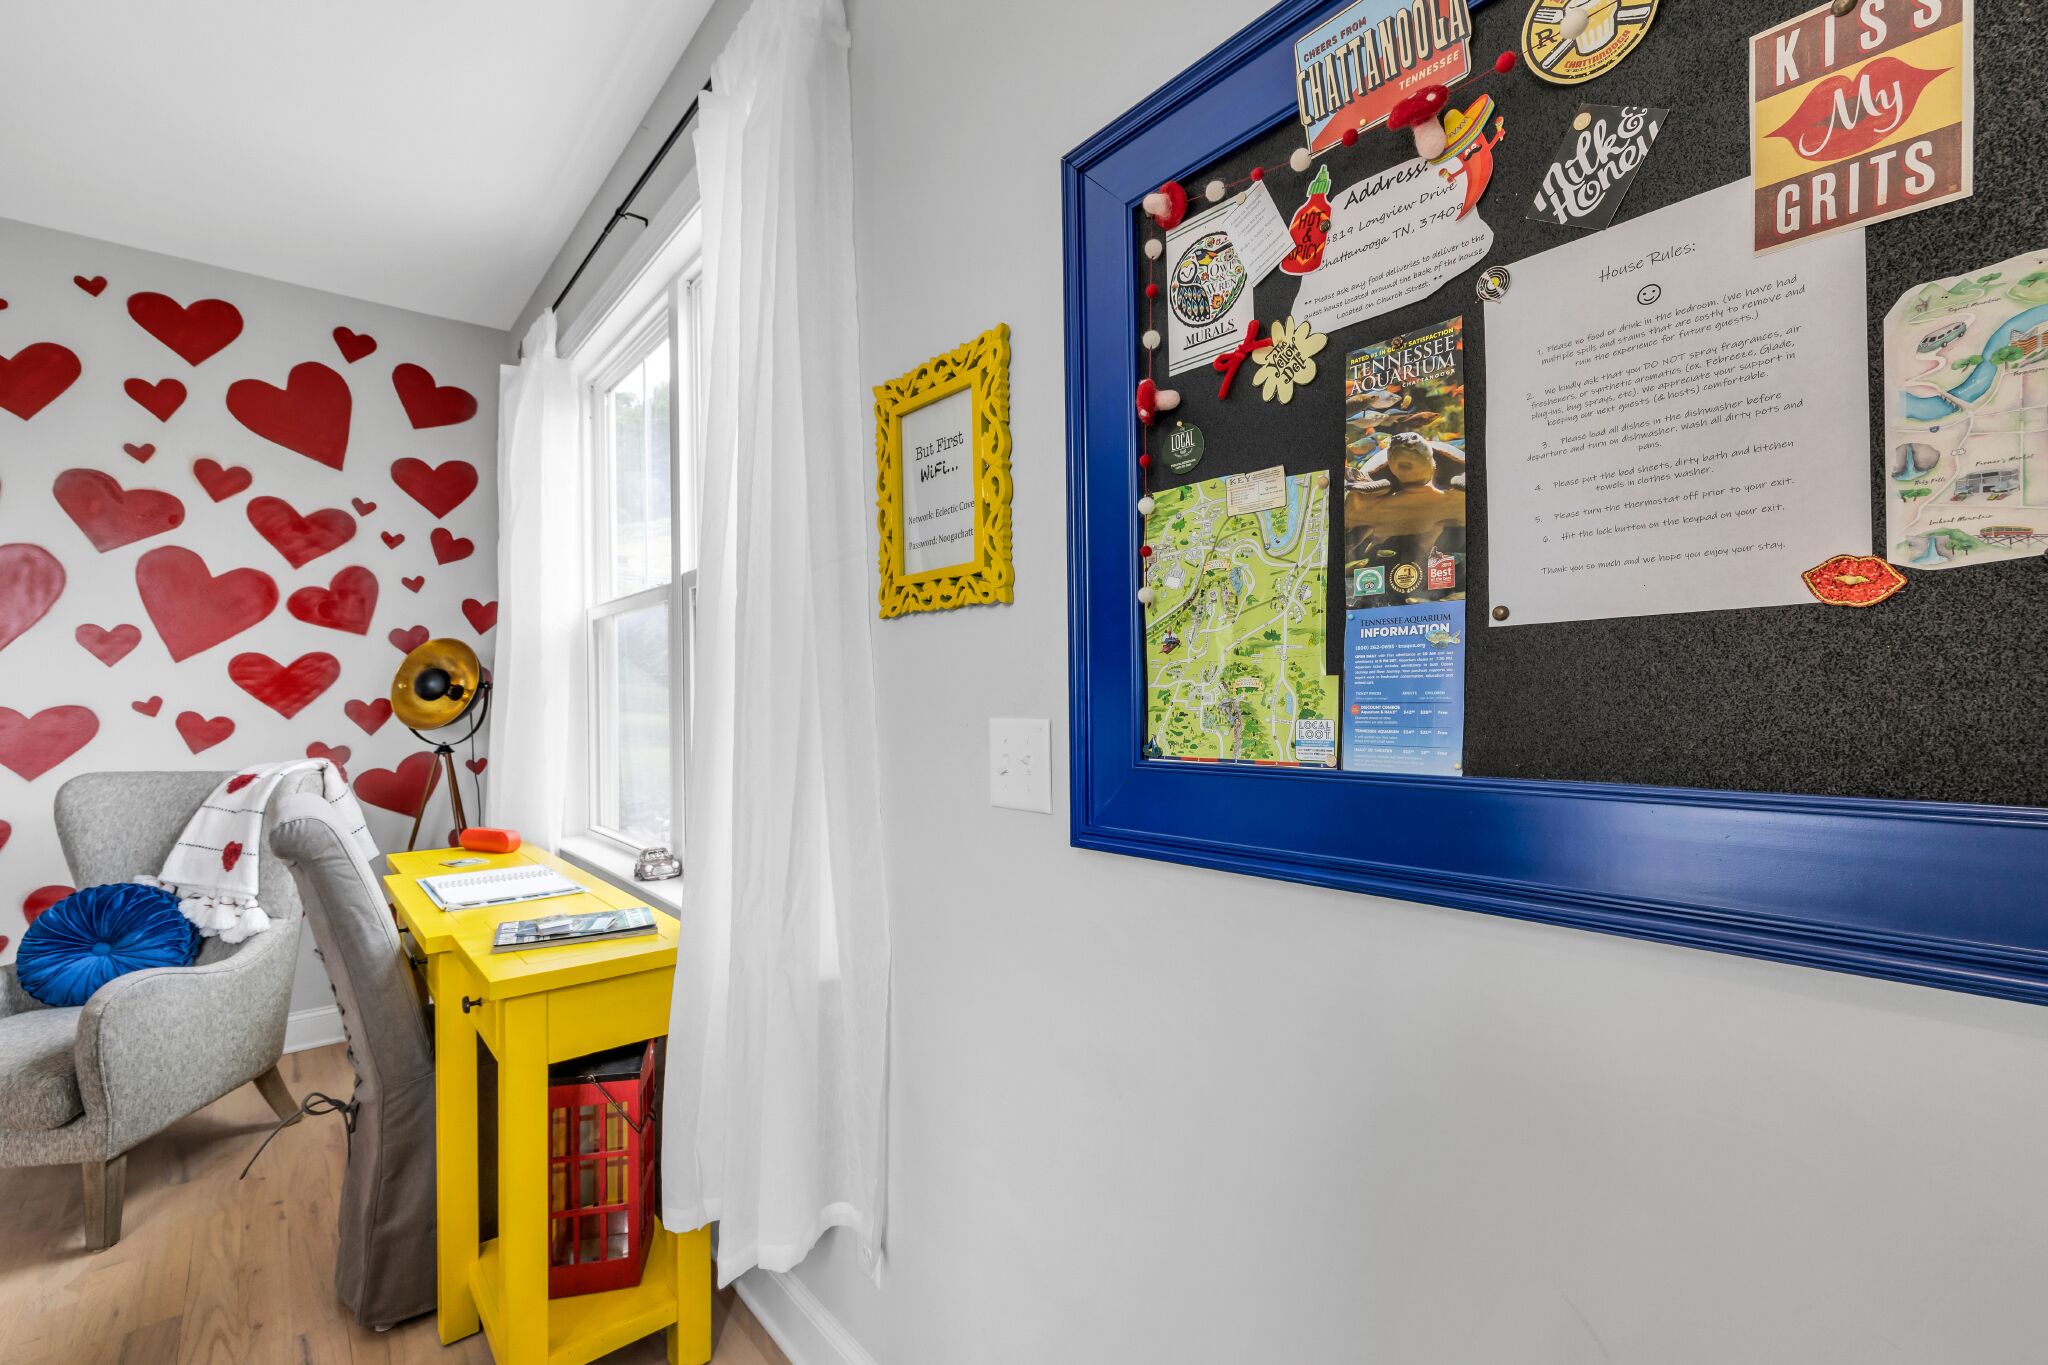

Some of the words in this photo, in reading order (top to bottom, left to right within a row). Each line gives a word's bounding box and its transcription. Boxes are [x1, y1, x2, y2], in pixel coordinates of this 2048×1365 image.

[1304, 35, 1339, 62] CHEERS
[1341, 16, 1368, 40] FROM
[1564, 30, 1631, 69] CHATTANOOGA
[1298, 0, 1467, 125] CHATTANOOGA
[1399, 50, 1459, 91] TENNESSEE
[1617, 106, 1648, 139] &
[1799, 74, 1903, 157] My
[1358, 201, 1417, 231] Longview
[1420, 182, 1458, 205] Drive
[1776, 140, 1936, 235] GRITS
[1298, 210, 1328, 230] HOT
[1302, 227, 1312, 243] &
[1393, 223, 1415, 239] TN,
[1420, 203, 1464, 229] 37409
[1314, 293, 1335, 305] Please
[1336, 286, 1349, 297] ask
[1351, 281, 1366, 291] any
[1368, 272, 1384, 287] food
[1385, 259, 1420, 279] deliveries
[1422, 254, 1430, 263] to
[1432, 244, 1459, 260] deliver
[1461, 240, 1469, 248] to
[1471, 233, 1485, 244] the
[1324, 301, 1343, 313] house
[1370, 279, 1398, 297] around
[1399, 274, 1412, 284] the
[1413, 267, 1432, 280] back
[1434, 260, 1443, 272] of
[1444, 257, 1457, 268] the
[1458, 247, 1485, 262] house.
[1598, 259, 1644, 283] House
[1647, 242, 1695, 266] Rules:
[1336, 304, 1363, 320] Located
[1365, 302, 1374, 311] on
[1376, 290, 1403, 306] Church
[1405, 281, 1431, 296] Street.
[1545, 340, 1572, 353] Please
[1587, 329, 1605, 342] food
[1607, 328, 1617, 336] or
[1618, 319, 1642, 333] drink
[1644, 317, 1652, 325] in
[1654, 311, 1672, 322] the
[1722, 292, 1742, 304] (We
[1745, 283, 1773, 297] have
[1776, 273, 1797, 288] had
[1185, 318, 1236, 347] MURALS
[1541, 350, 1574, 365] multiple
[1576, 344, 1597, 356] spills
[1599, 337, 1615, 349] and
[1617, 331, 1646, 344] stains
[1648, 322, 1673, 336] that
[1674, 318, 1691, 331] are
[1694, 308, 1724, 323] costly
[1741, 293, 1782, 310] remove
[1784, 283, 1805, 298] and
[1265, 339, 1288, 361] The
[1266, 336, 1299, 379] Yellow
[1350, 354, 1370, 366] RATED
[1408, 327, 1454, 347] SATISFACTION
[1350, 335, 1455, 381] TENNESSEE
[1544, 387, 1556, 395] We
[1558, 380, 1581, 392] kindly
[1583, 375, 1599, 386] ask
[1600, 369, 1624, 380] that
[1625, 366, 1641, 376] you
[1642, 360, 1659, 370] DO
[1662, 352, 1686, 366] NOT
[1689, 346, 1718, 359] spray
[1720, 331, 1783, 352] fragrances,
[1785, 325, 1802, 335] air
[1281, 354, 1307, 385] Deli
[1350, 352, 1456, 397] AQUARIUM
[1402, 368, 1456, 388] CHATTANOOGA
[915, 442, 935, 461] But
[936, 431, 964, 453] First
[1171, 430, 1196, 452] LOCAL
[1230, 475, 1251, 486] KEY
[1553, 510, 1580, 520] Please
[1582, 507, 1602, 515] turn
[1603, 504, 1621, 512] the
[1623, 495, 1680, 509] thermostat
[1682, 490, 1699, 501] off
[1702, 488, 1726, 499] prior
[1744, 481, 1767, 493] your
[1770, 477, 1796, 487] exit.
[1561, 531, 1576, 541] Hit
[1577, 529, 1594, 538] the
[1596, 526, 1612, 535] lock
[1614, 523, 1646, 533] button
[1661, 517, 1680, 526] the
[1682, 511, 1718, 524] keypad
[1720, 511, 1732, 519] on
[1734, 507, 1758, 518] your
[1761, 503, 1785, 513] exit.
[1430, 567, 1453, 579] Best
[1540, 564, 1568, 574] Thank
[1569, 564, 1584, 572] you
[1597, 559, 1621, 568] much
[1623, 555, 1640, 566] and
[1642, 554, 1656, 564] we
[1658, 553, 1682, 562] hope
[1684, 551, 1701, 560] you
[1703, 546, 1729, 557] enjoy
[1731, 544, 1755, 555] your
[1757, 541, 1786, 551] stay.
[1360, 616, 1404, 627] TENNESSEE
[1404, 613, 1452, 624] AQUARIUM
[1360, 621, 1451, 639] INFORMATION
[1298, 720, 1332, 731] LOCAL
